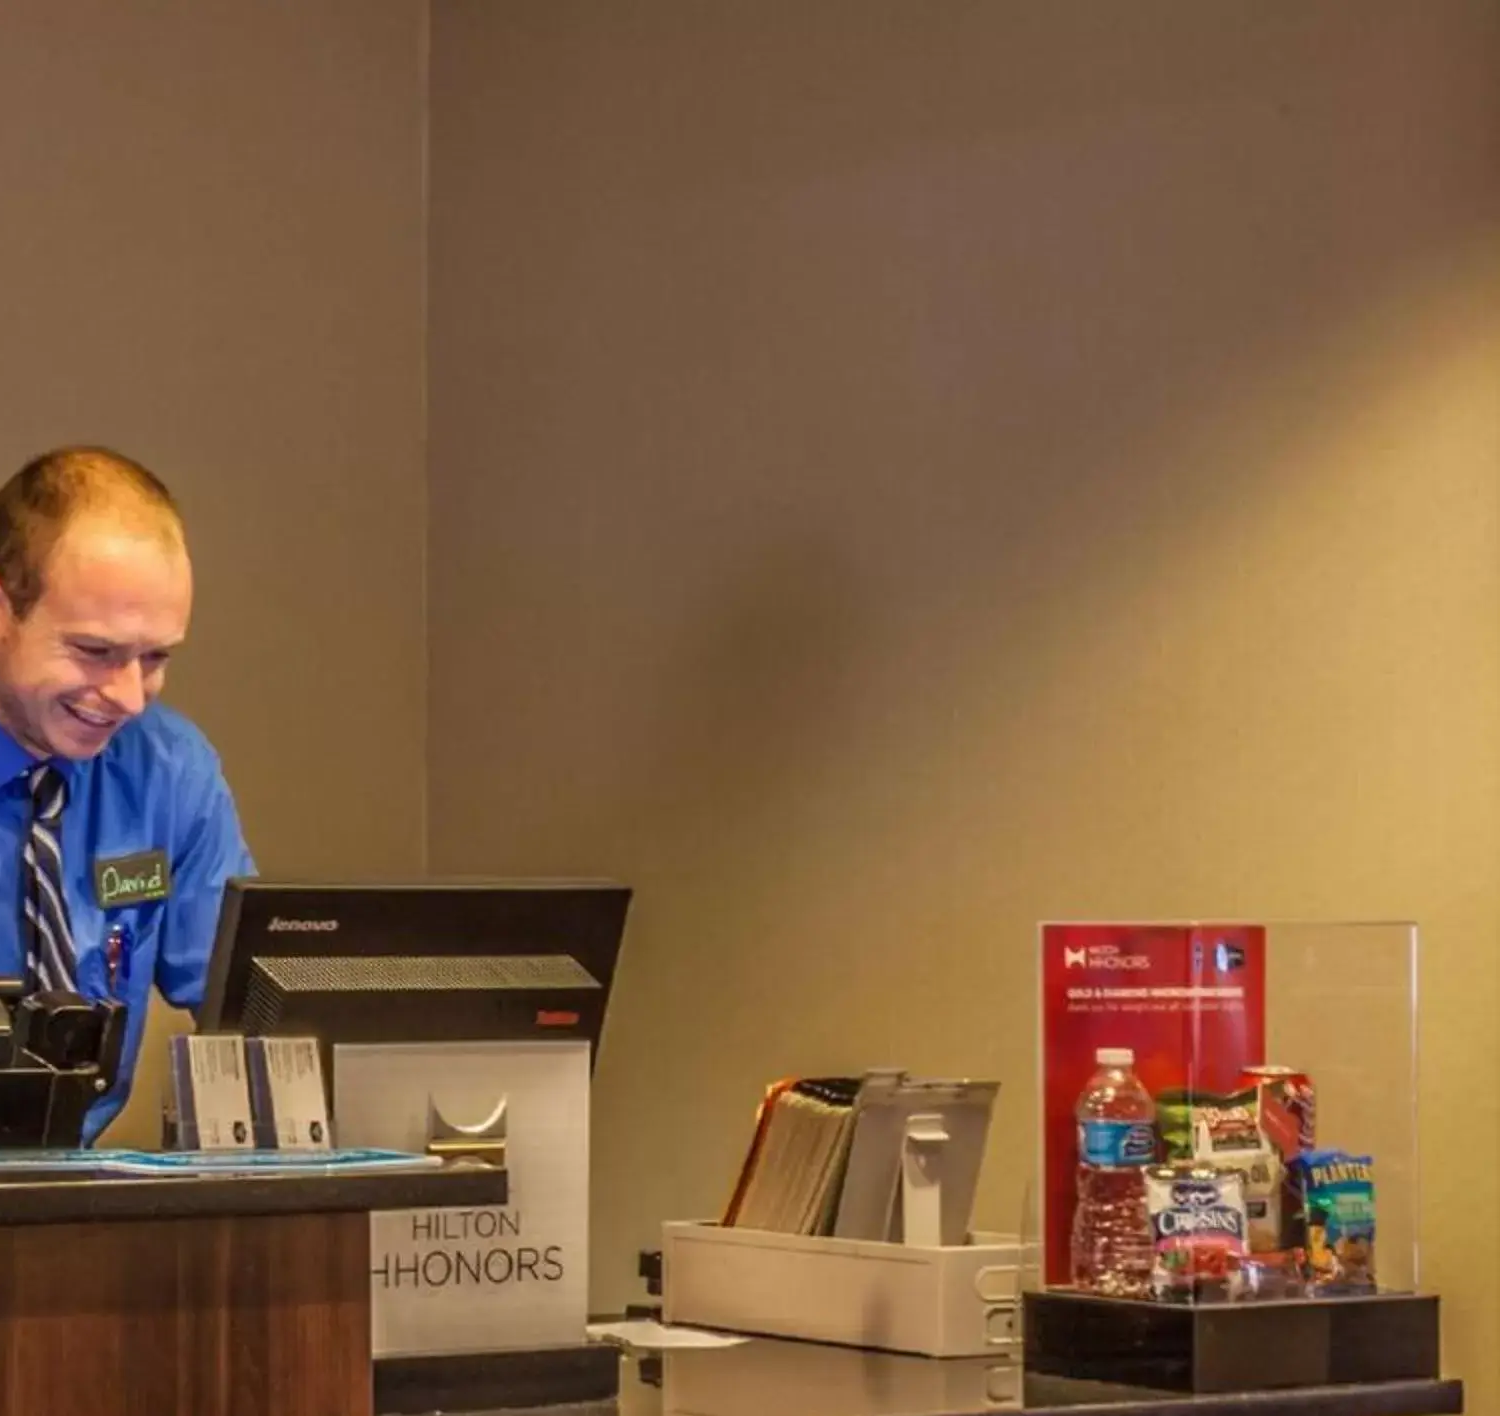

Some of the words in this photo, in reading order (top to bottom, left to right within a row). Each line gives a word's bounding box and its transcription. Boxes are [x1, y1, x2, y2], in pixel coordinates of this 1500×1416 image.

[102, 864, 161, 903] David
[267, 916, 339, 932] lenovo
[412, 1211, 520, 1241] HILTON
